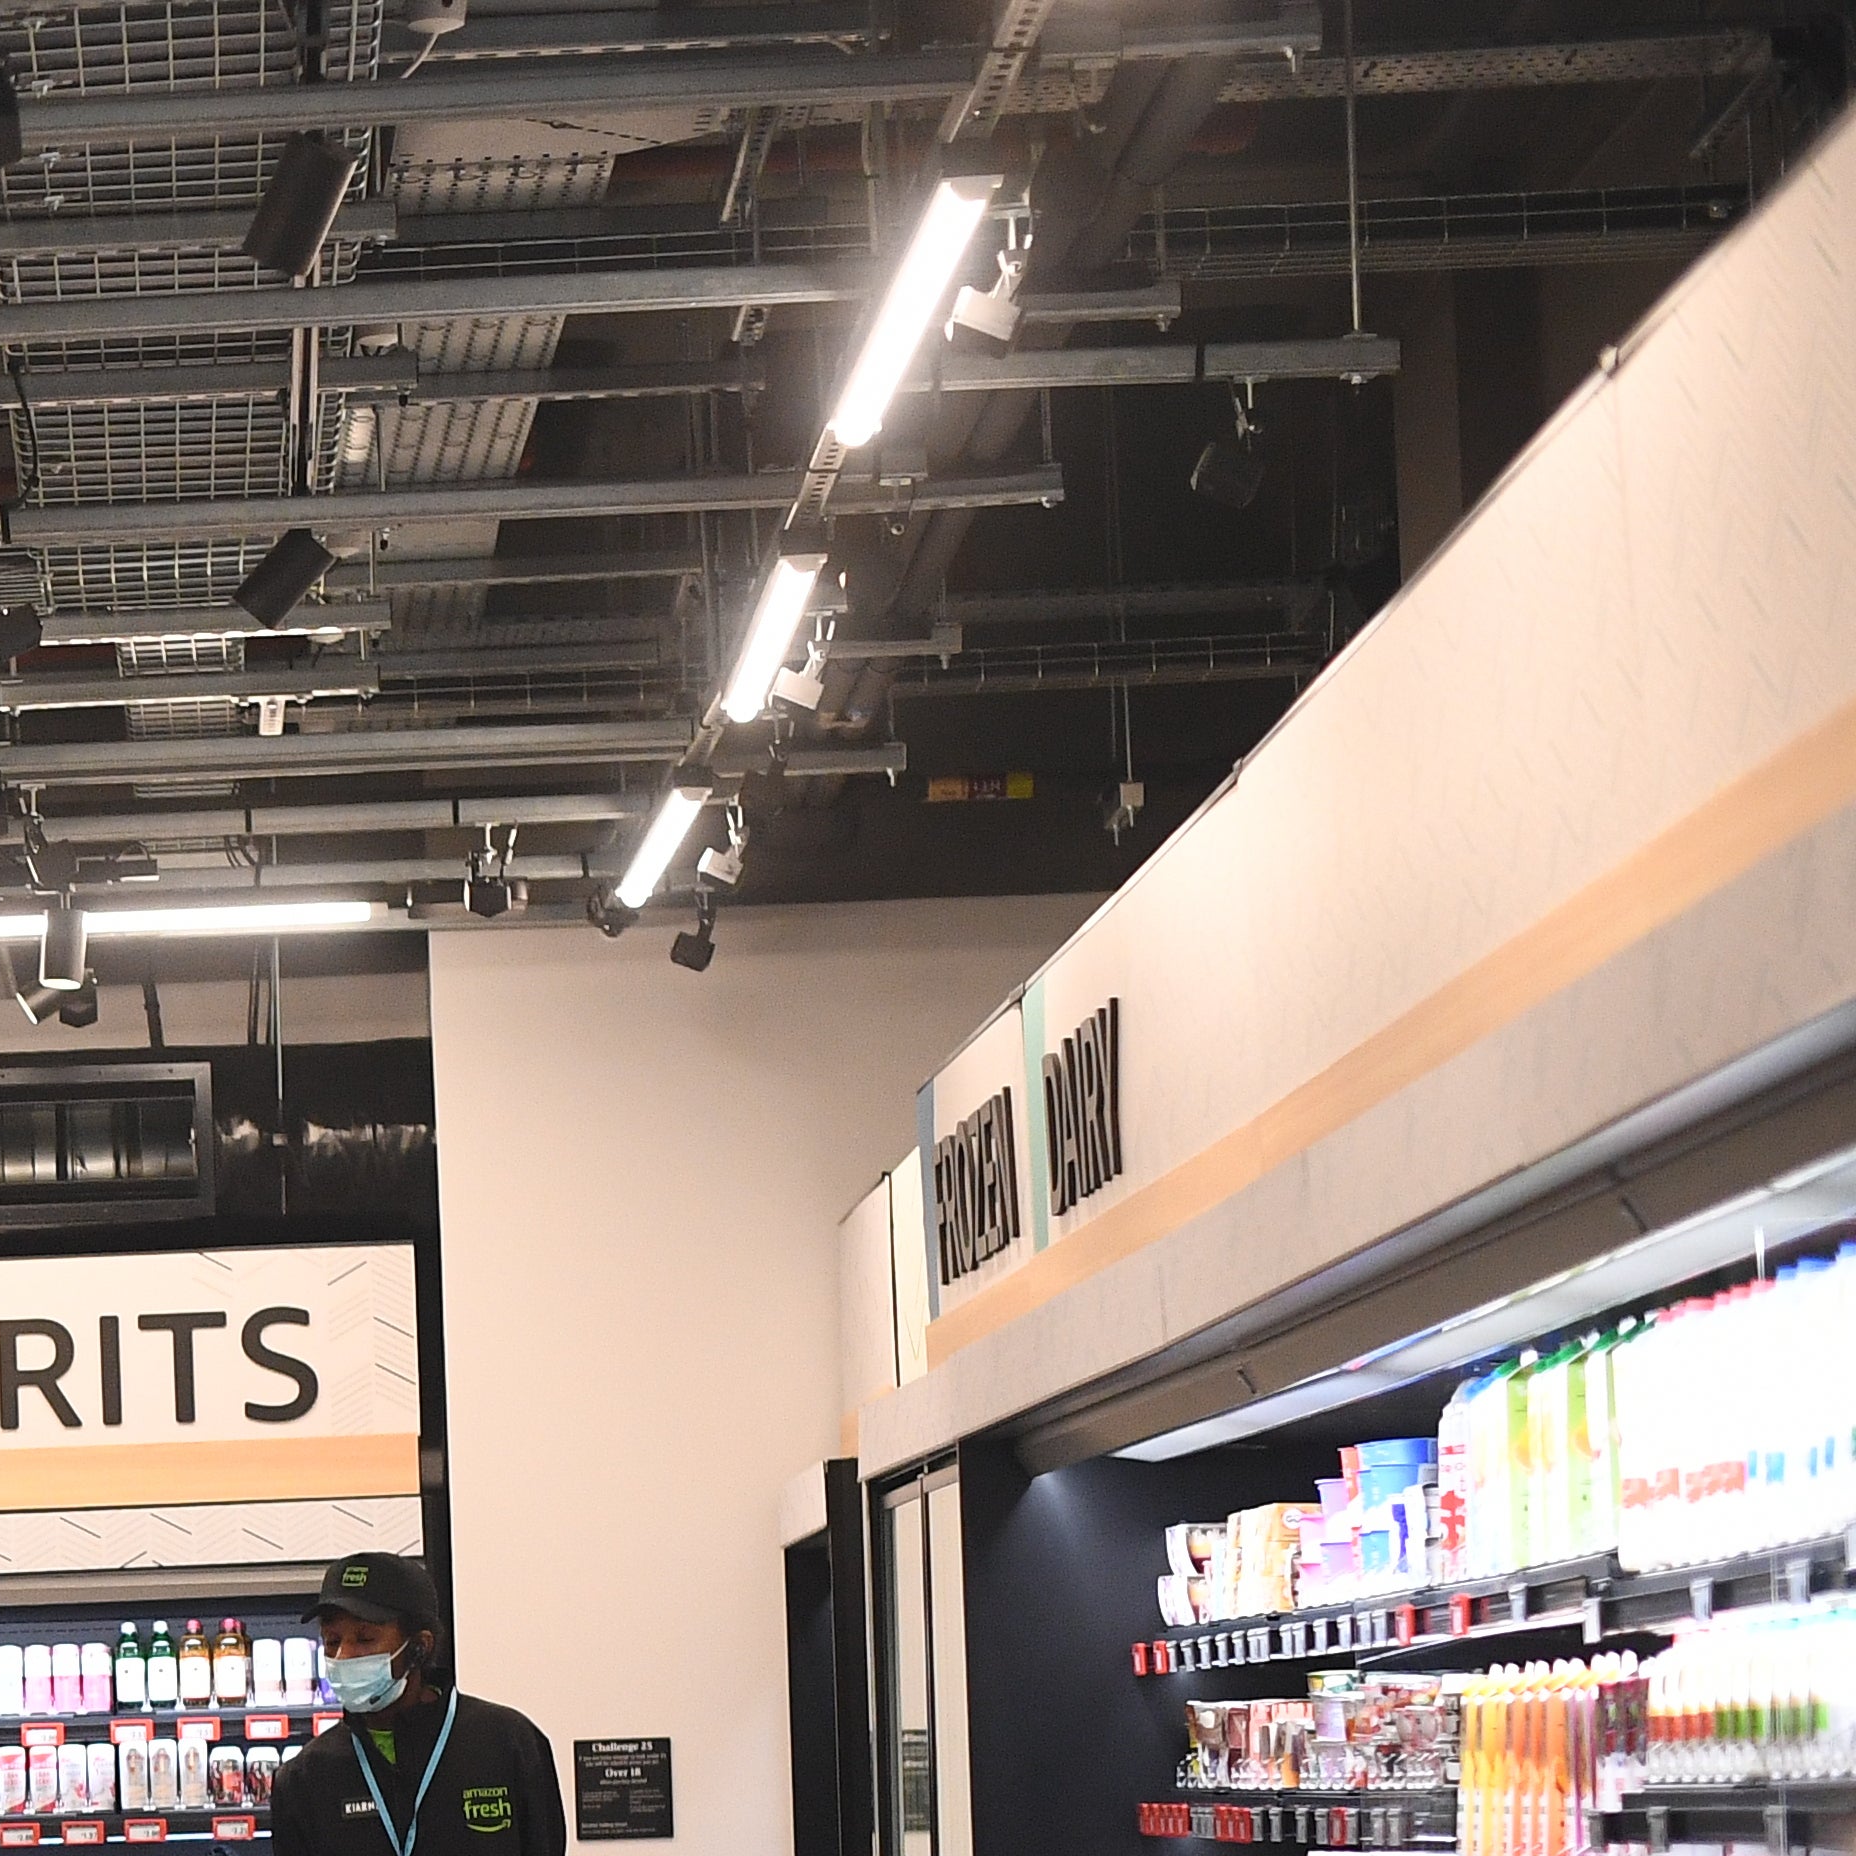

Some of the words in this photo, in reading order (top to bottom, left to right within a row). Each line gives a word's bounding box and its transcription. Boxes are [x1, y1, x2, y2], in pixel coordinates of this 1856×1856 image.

[1042, 997, 1123, 1216] DAIRY
[934, 1086, 1021, 1286] FROZEN
[604, 1767, 628, 1778] Over
[463, 1786, 508, 1799] amazon
[345, 1801, 378, 1814] KIARN
[463, 1798, 512, 1820] fresh
